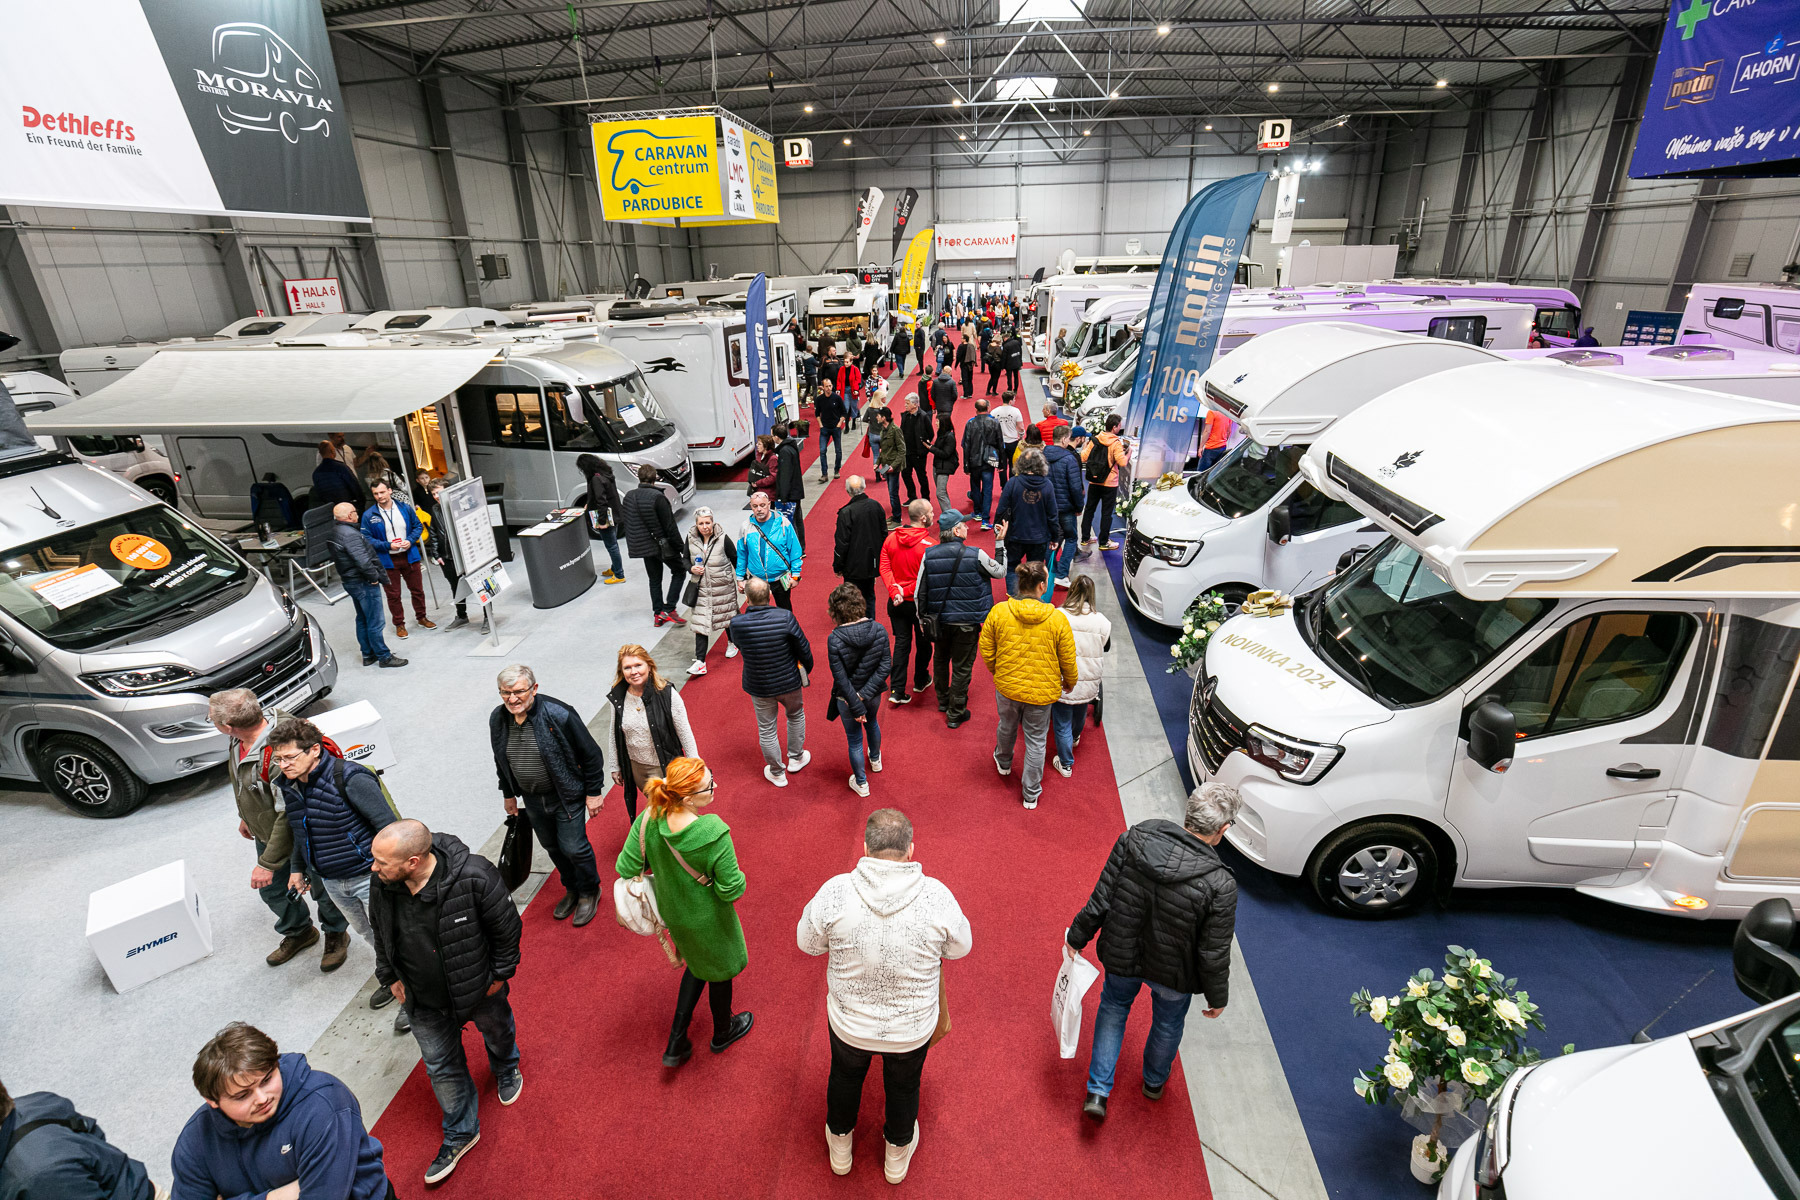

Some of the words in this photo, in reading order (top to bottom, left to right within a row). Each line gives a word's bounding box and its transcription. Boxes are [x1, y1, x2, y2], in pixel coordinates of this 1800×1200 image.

[1739, 53, 1796, 82] AHORN
[193, 68, 334, 113] MORAVIA
[197, 84, 230, 97] CENTRUM
[1671, 74, 1715, 98] notin
[22, 105, 136, 142] Dethleffs
[1270, 122, 1285, 139] D
[26, 132, 45, 145] Ein
[47, 135, 84, 150] Freund
[86, 140, 104, 152] der
[107, 143, 143, 156] Familie
[634, 144, 707, 161] CARAVAN
[789, 142, 803, 157] D
[1665, 134, 1712, 160] Měníme
[1714, 125, 1745, 152] vaše
[1745, 128, 1776, 150] sny
[1778, 125, 1791, 142] v
[648, 162, 709, 176] centrum
[728, 161, 744, 183] LMC
[757, 158, 773, 175] CARAVAN
[622, 195, 703, 212] PARDUBICE
[755, 201, 776, 216] PARDUBICE
[865, 194, 875, 216] CAMPING
[901, 194, 911, 216] CAMPING
[944, 238, 961, 247] FOR
[963, 236, 1009, 247] CARAVAN
[302, 286, 329, 298] HALA
[330, 285, 336, 296] 6
[1175, 234, 1226, 346] notin
[1198, 237, 1236, 348] CAMPING-CARS
[755, 322, 769, 398] HYMER
[1162, 365, 1200, 398] 100
[1152, 397, 1189, 423] Ans
[1220, 633, 1291, 668] NOVINKA
[1285, 662, 1336, 690] 2024
[342, 744, 375, 760] carado
[136, 931, 178, 954] HYMER
